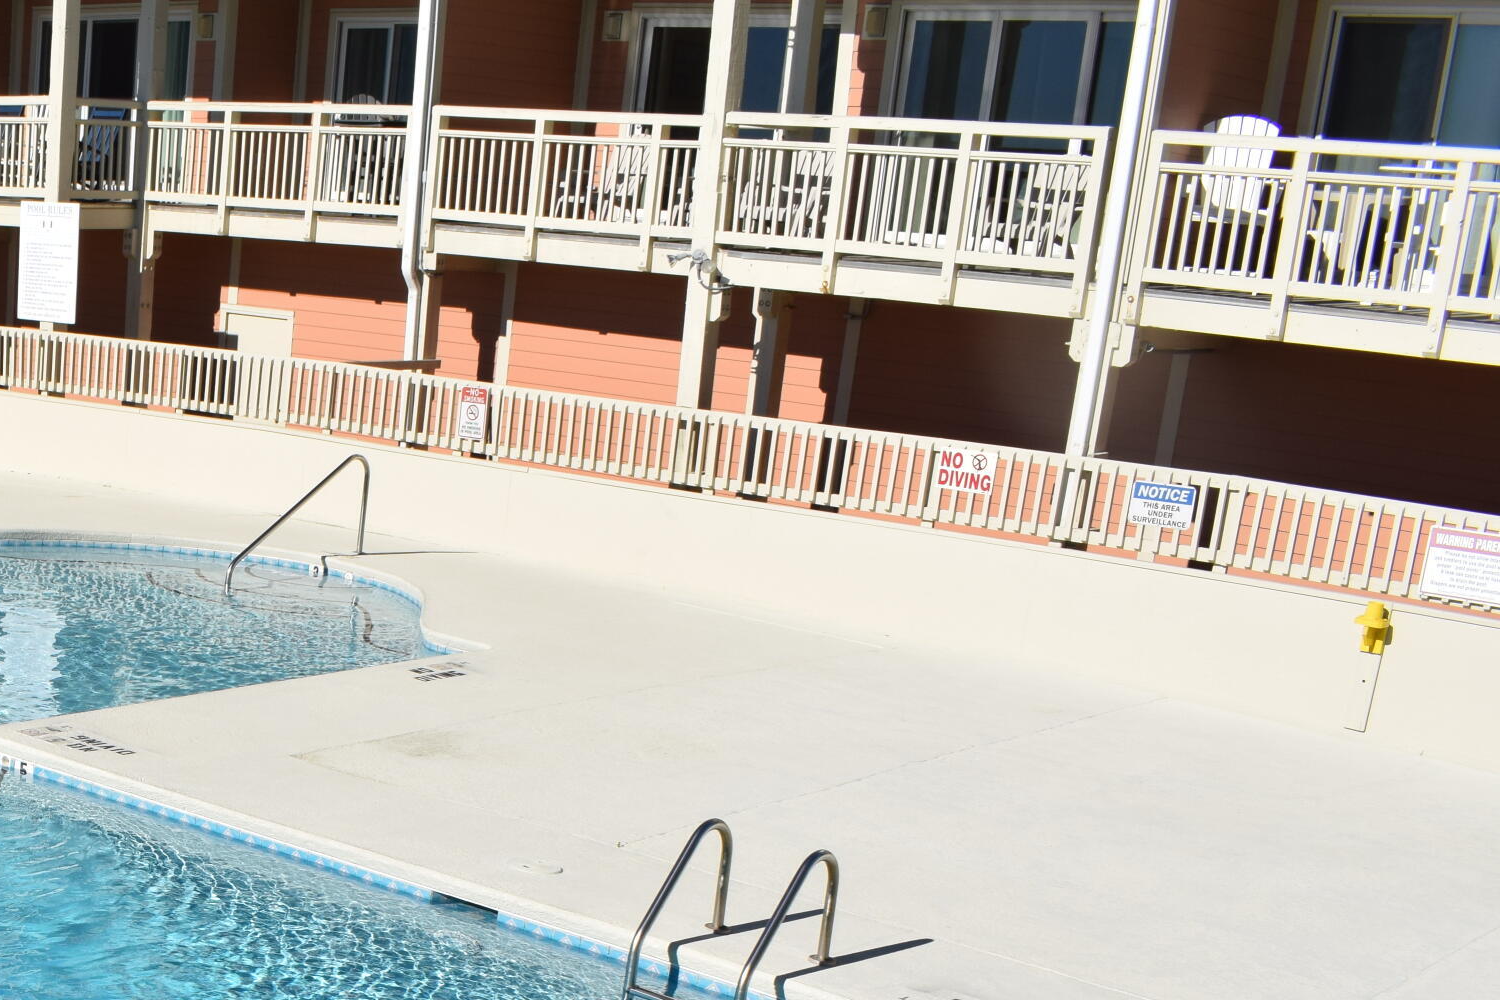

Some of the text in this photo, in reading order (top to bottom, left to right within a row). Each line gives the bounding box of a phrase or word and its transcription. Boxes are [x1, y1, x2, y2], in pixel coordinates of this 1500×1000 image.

[940, 450, 963, 469] NO
[937, 468, 991, 492] DIVING
[1138, 485, 1190, 503] NOTICE
[1143, 502, 1181, 512] THIS AREA
[1147, 510, 1173, 518] UNDER
[1132, 515, 1187, 529] SURVEILLANCE
[1436, 533, 1475, 549] WARNING
[413, 670, 467, 682] DIVING
[66, 743, 99, 752] NO
[70, 735, 137, 756] DIVING
[19, 761, 28, 776] 5
